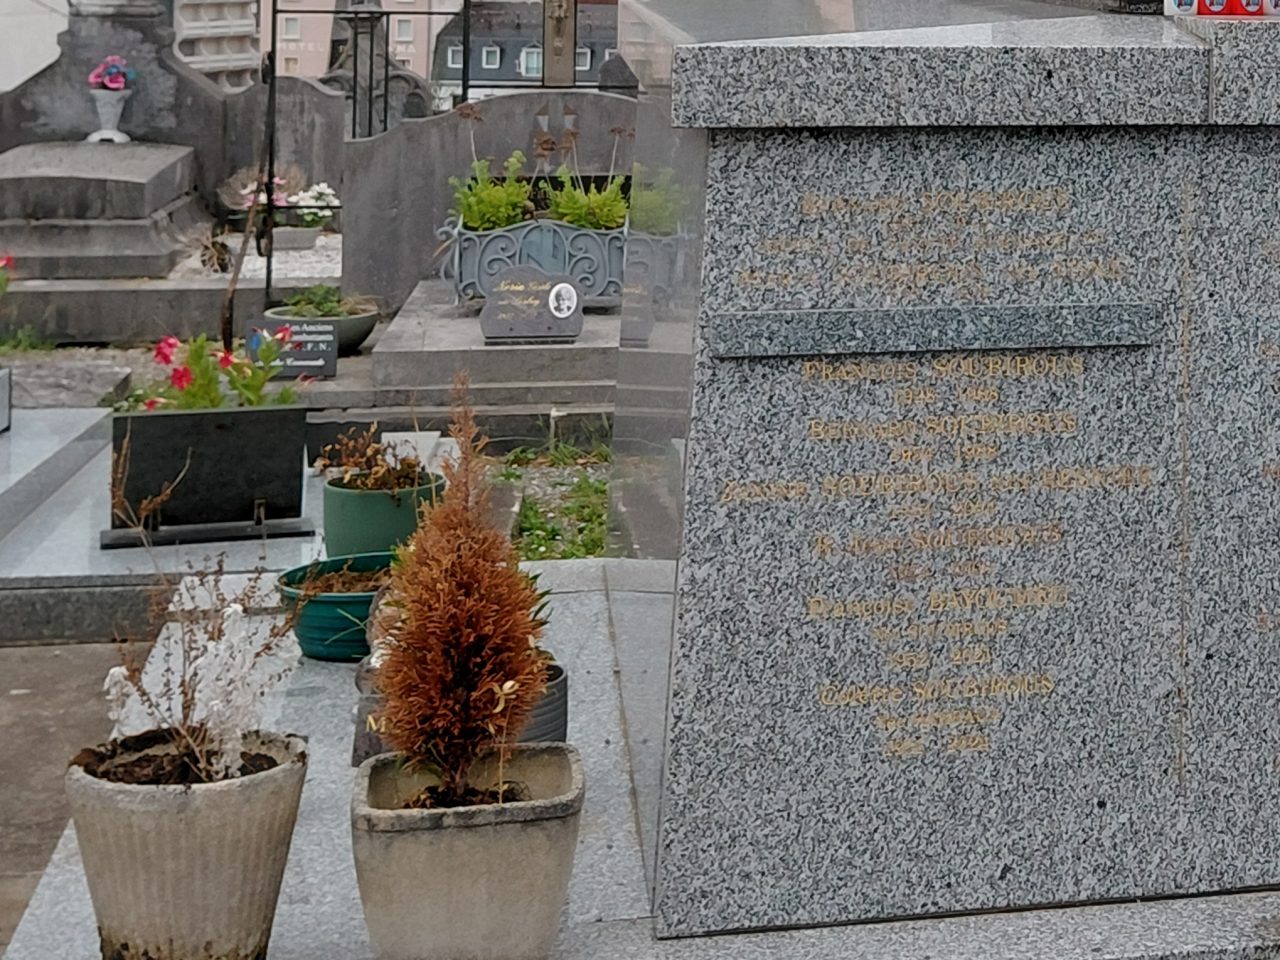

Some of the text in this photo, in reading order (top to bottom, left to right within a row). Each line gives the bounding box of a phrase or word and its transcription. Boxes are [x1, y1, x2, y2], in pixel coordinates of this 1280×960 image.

[932, 354, 1085, 378] SOUBIROUS
[925, 412, 1077, 436] SOUBIROUS
[820, 470, 977, 498] SOUBIROUS
